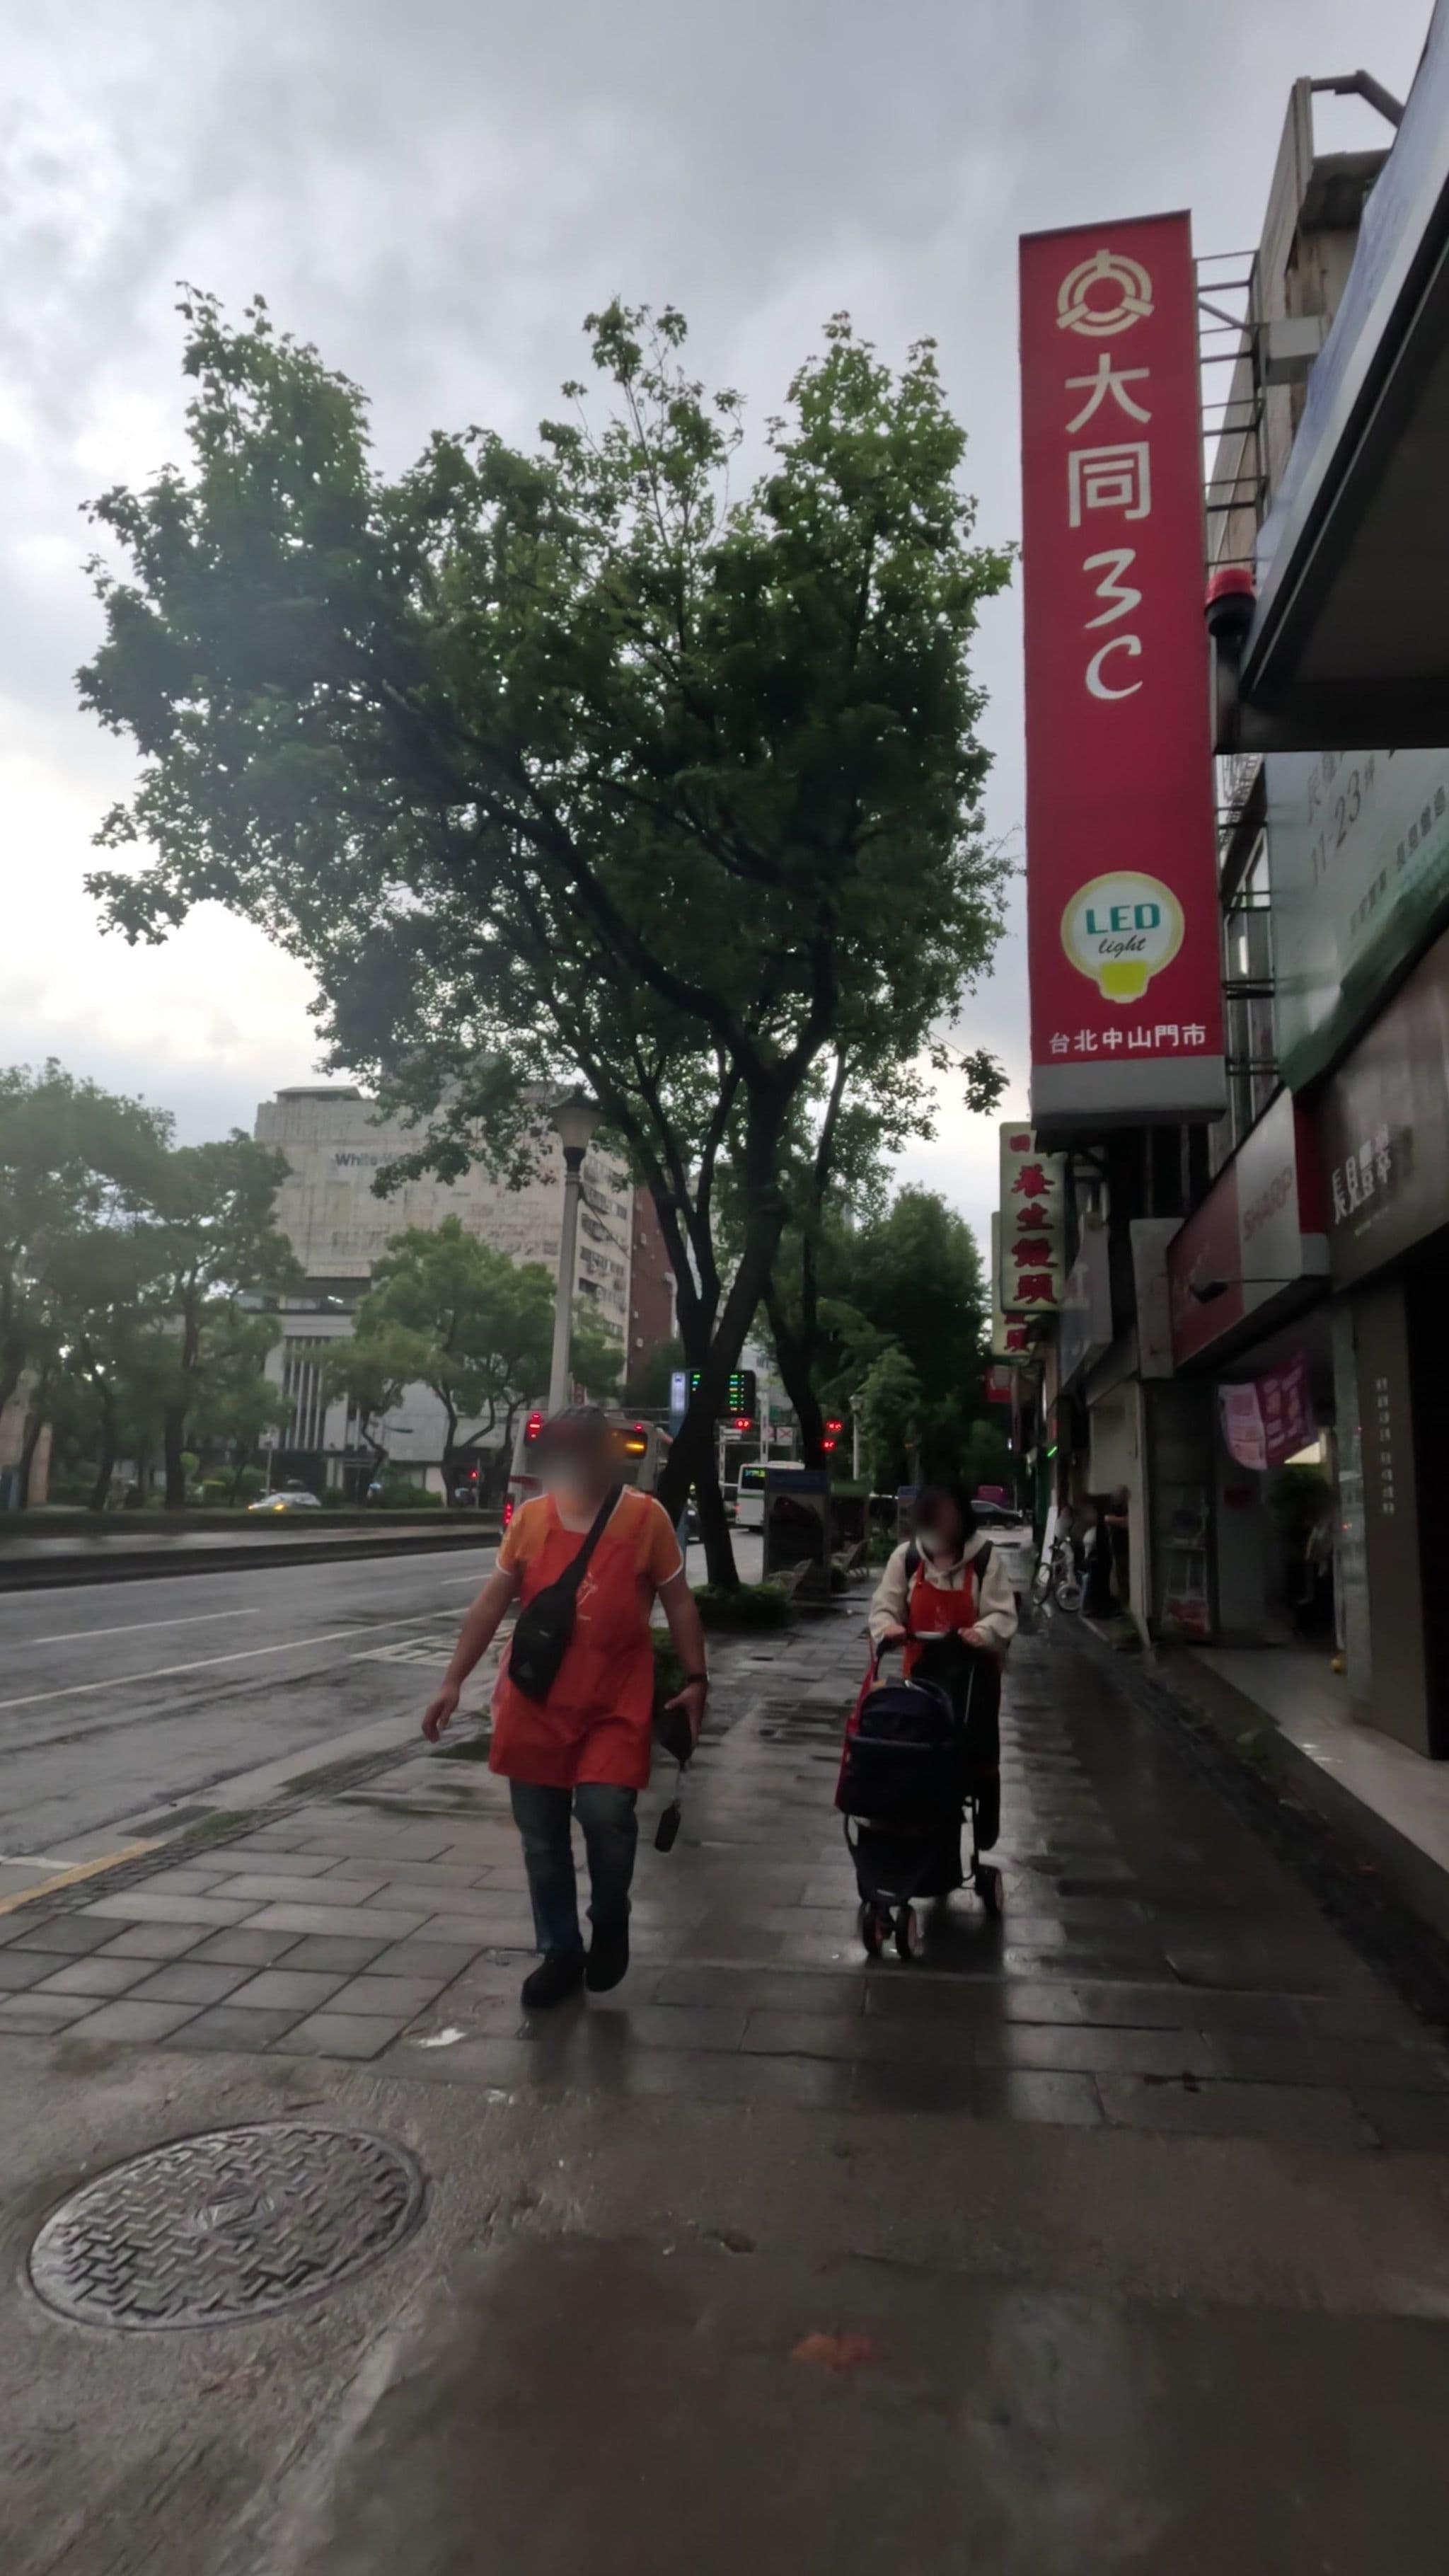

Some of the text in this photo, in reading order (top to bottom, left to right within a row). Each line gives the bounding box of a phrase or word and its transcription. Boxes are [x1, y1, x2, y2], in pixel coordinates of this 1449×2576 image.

[1085, 902, 1160, 935] LED
[1098, 935, 1146, 958] light
[1049, 1023, 1206, 1054] 台北中山門市
